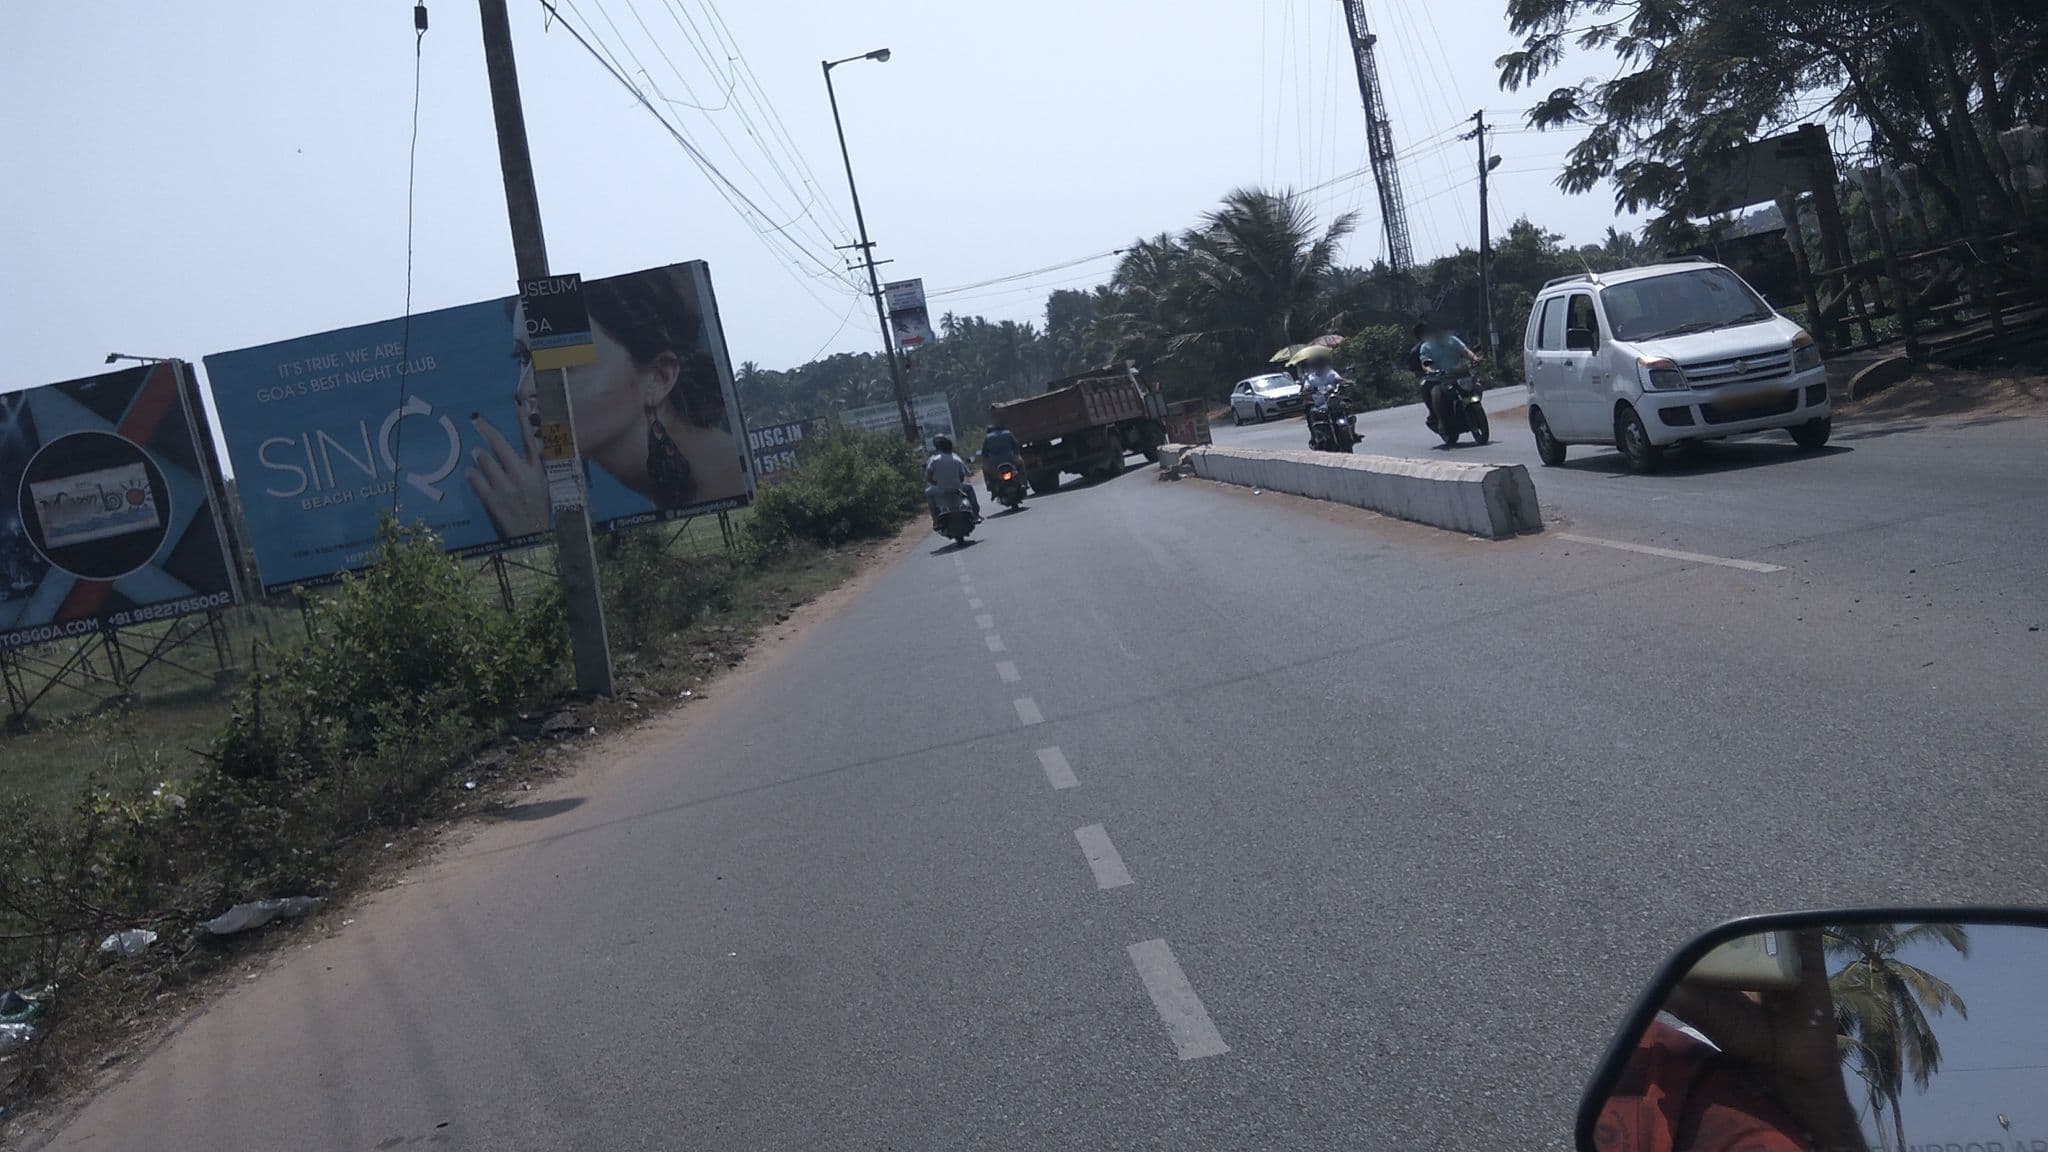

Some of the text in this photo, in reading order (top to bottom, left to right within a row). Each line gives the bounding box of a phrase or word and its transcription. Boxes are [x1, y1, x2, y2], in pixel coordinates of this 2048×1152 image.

[279, 361, 302, 378] IT'S
[346, 347, 370, 364] WE
[375, 341, 404, 359] ARE
[257, 355, 437, 403] GOA'S BEST NIGHT CLUB
[258, 395, 462, 501] SINQ
[301, 481, 399, 511] BEACH CLUB
[1, 618, 99, 647] TOSGOA.COM
[108, 611, 131, 626] +91
